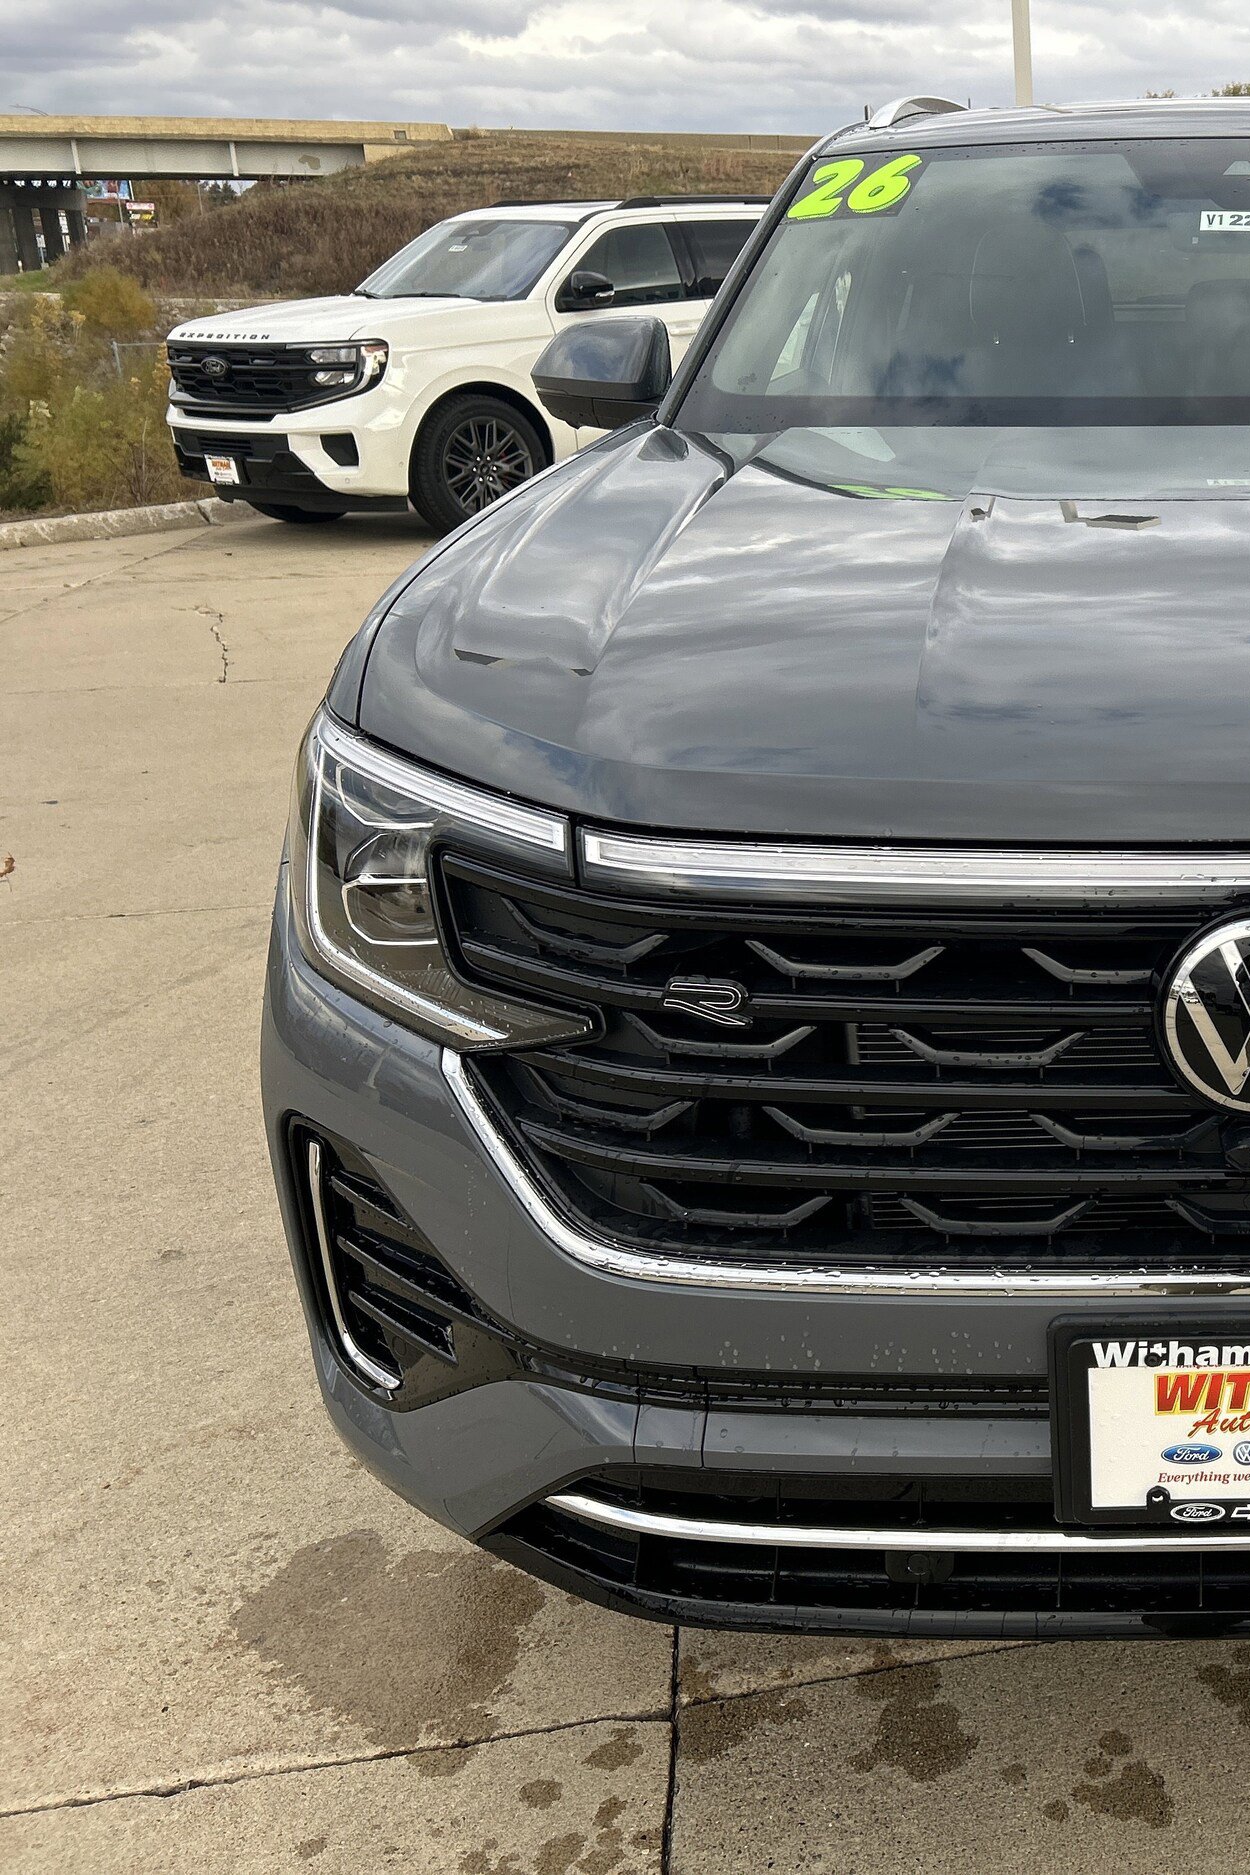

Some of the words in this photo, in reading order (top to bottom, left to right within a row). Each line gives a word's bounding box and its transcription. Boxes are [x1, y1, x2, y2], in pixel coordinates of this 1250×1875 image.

[787, 154, 922, 220] 26
[179, 332, 270, 340] EXPEDITION
[1173, 1446, 1210, 1461] Ford
[1157, 1471, 1231, 1485] Everything
[1182, 1506, 1213, 1518] Ford
